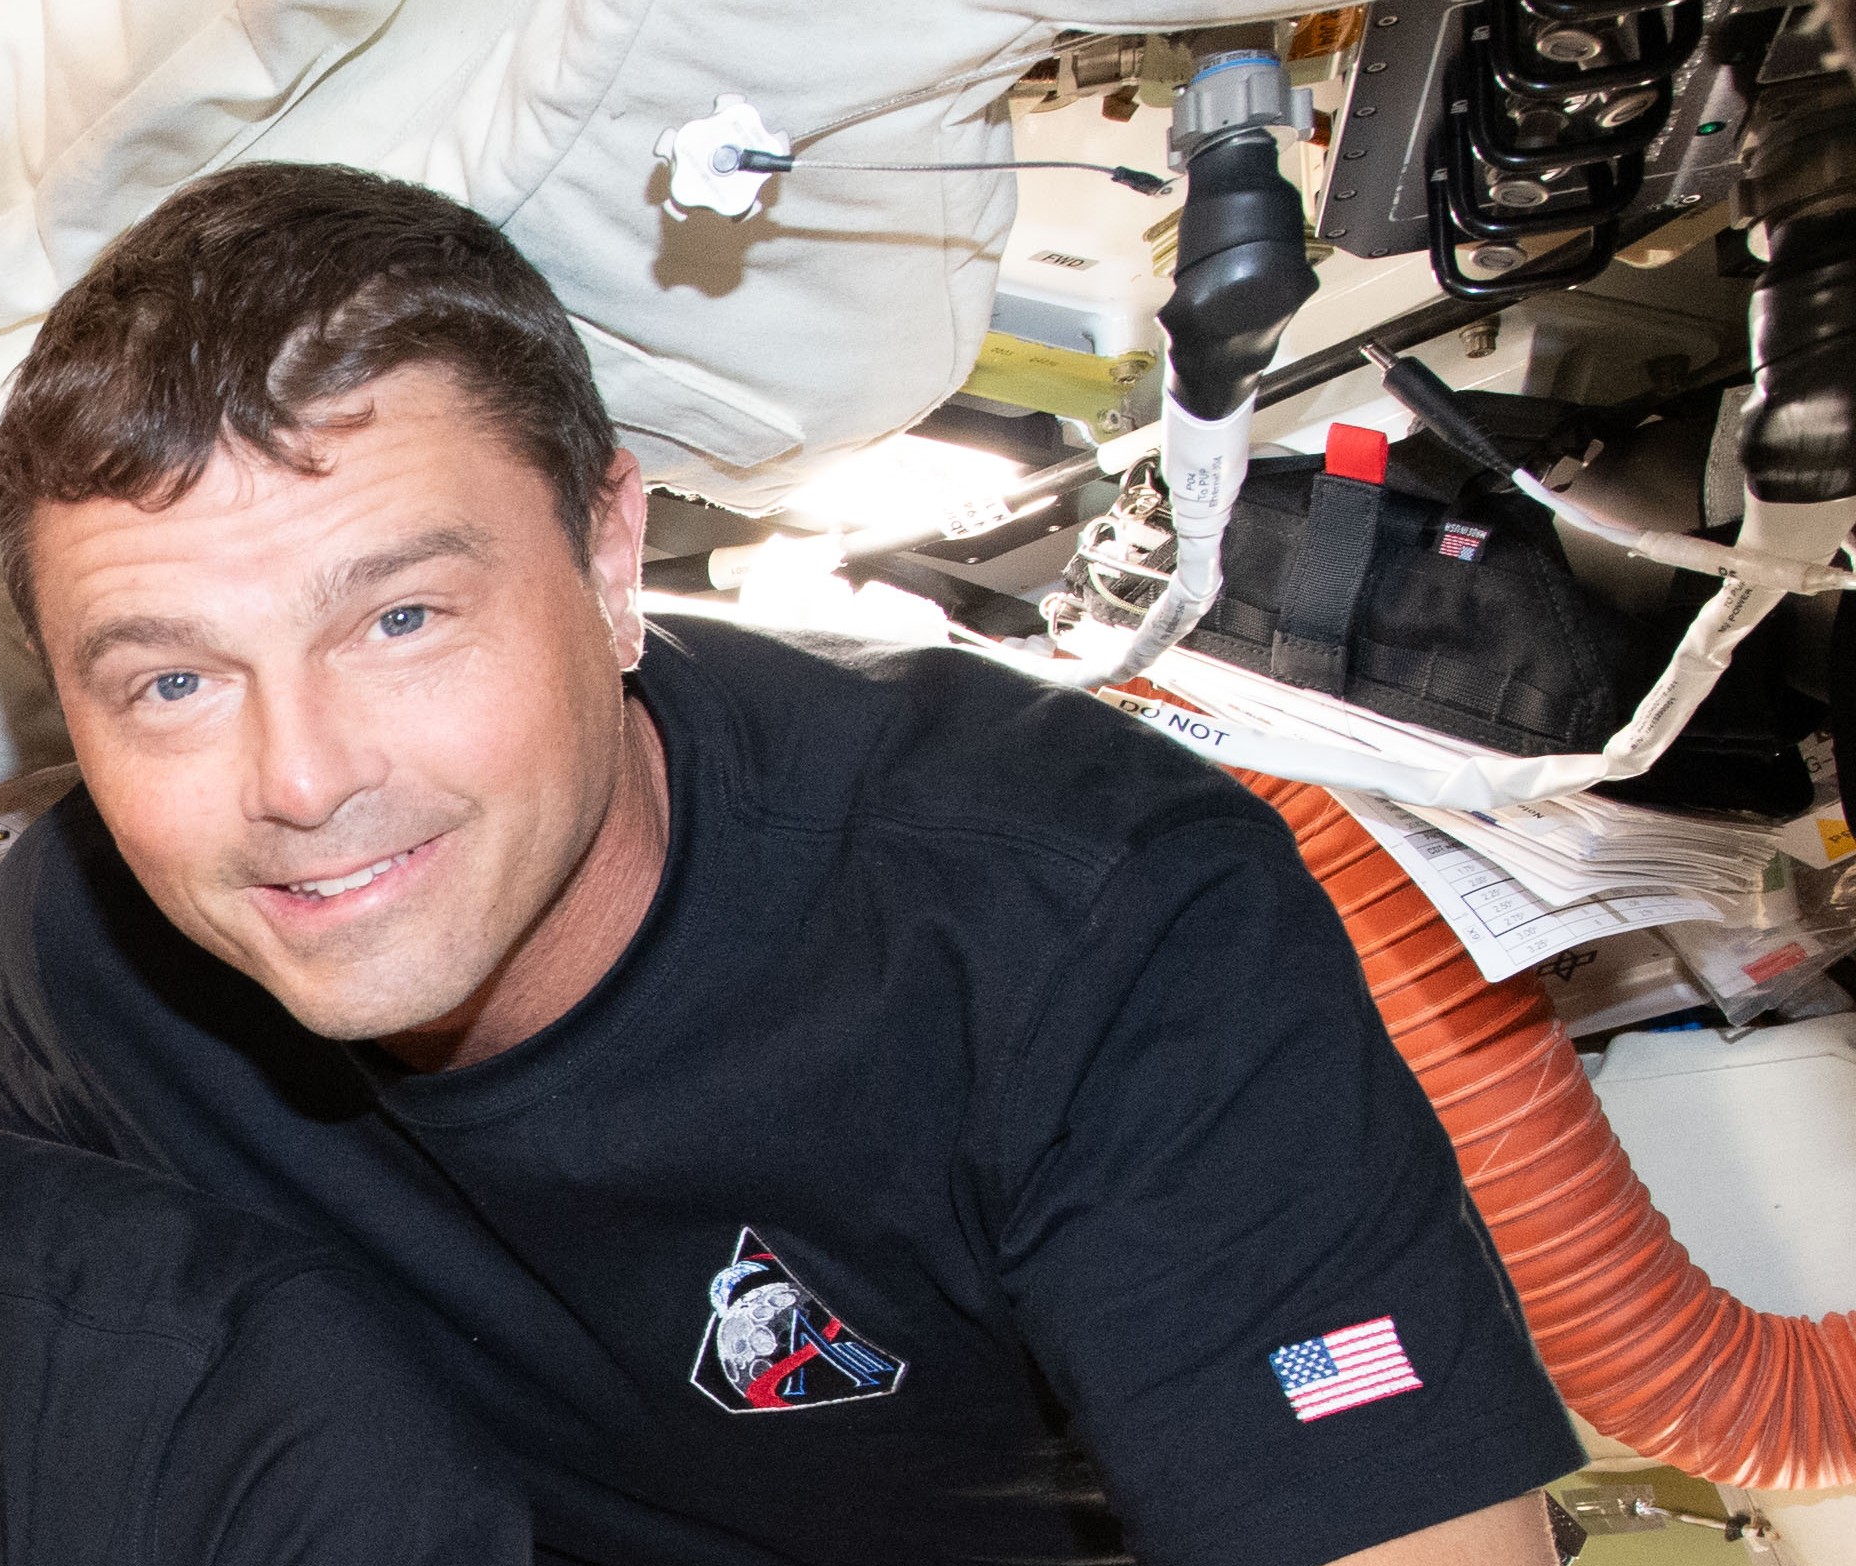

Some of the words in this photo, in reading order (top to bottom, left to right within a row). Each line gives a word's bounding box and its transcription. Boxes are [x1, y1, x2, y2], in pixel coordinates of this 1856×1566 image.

[1042, 253, 1085, 268] FWD
[1118, 699, 1160, 719] DO
[1167, 713, 1230, 747] NOT
